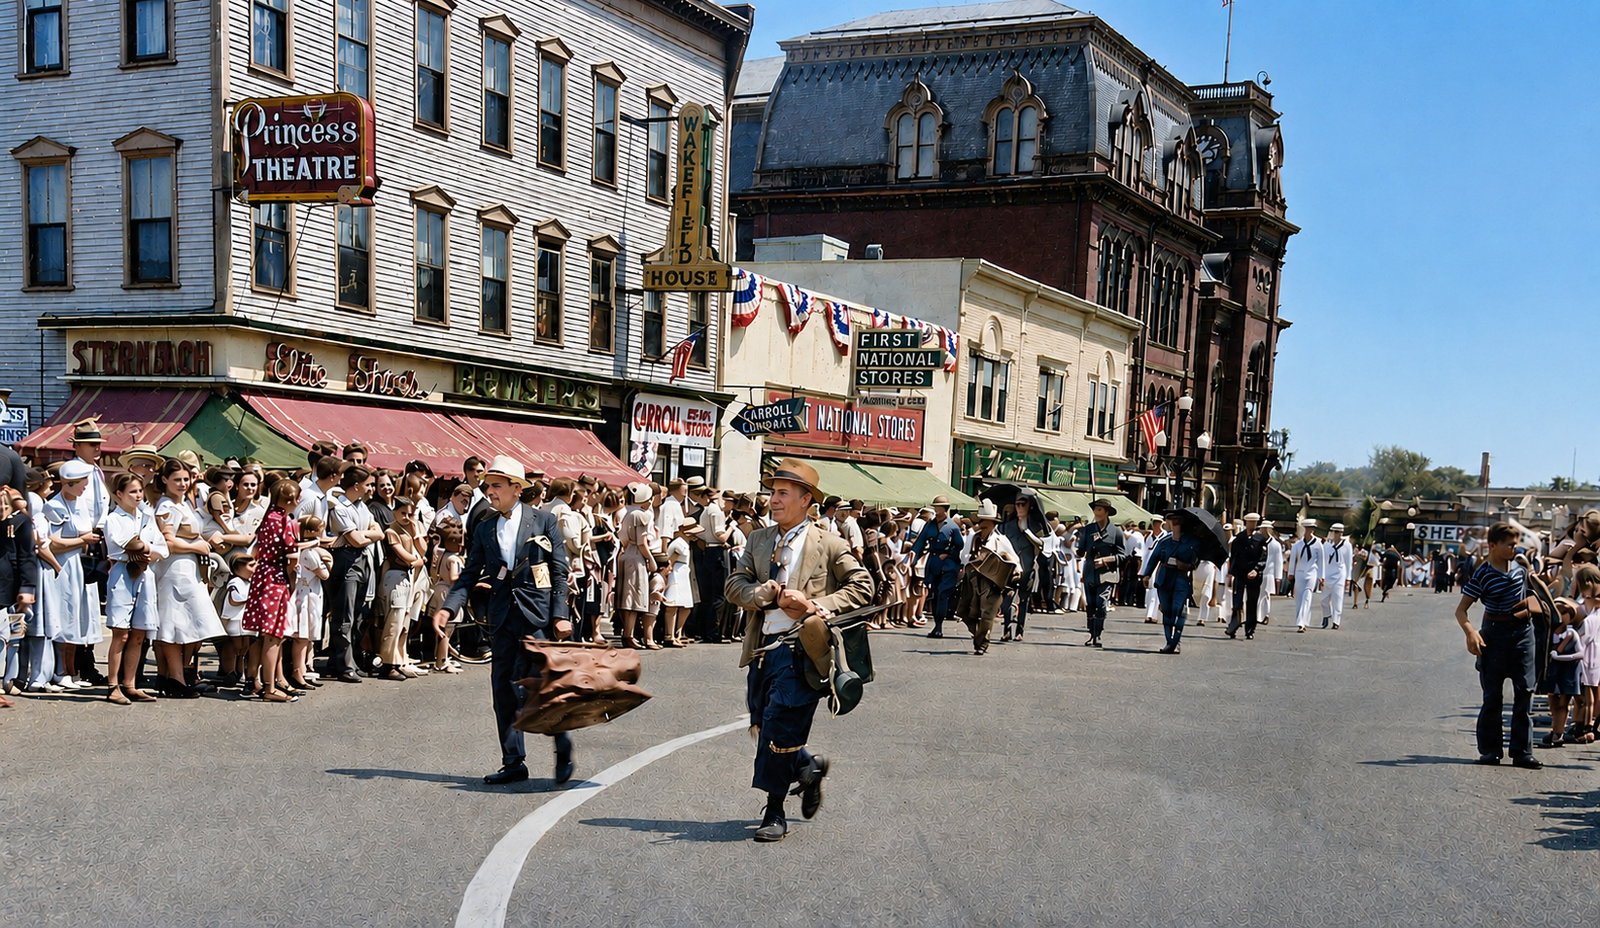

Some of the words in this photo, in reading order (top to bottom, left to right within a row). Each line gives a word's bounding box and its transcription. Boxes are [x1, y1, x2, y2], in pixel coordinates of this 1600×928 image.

[234, 102, 358, 177] Princess
[251, 155, 358, 182] THEATRE
[678, 115, 700, 265] WAKEFIELD
[650, 269, 718, 287] HOUSE
[860, 332, 916, 347] FIRST
[265, 342, 329, 389] Elite
[859, 352, 936, 367] NATIONAL
[859, 370, 925, 386] STORES
[743, 404, 793, 421] CARROLL
[817, 403, 874, 437] NATIONAL
[877, 412, 917, 443] STORES
